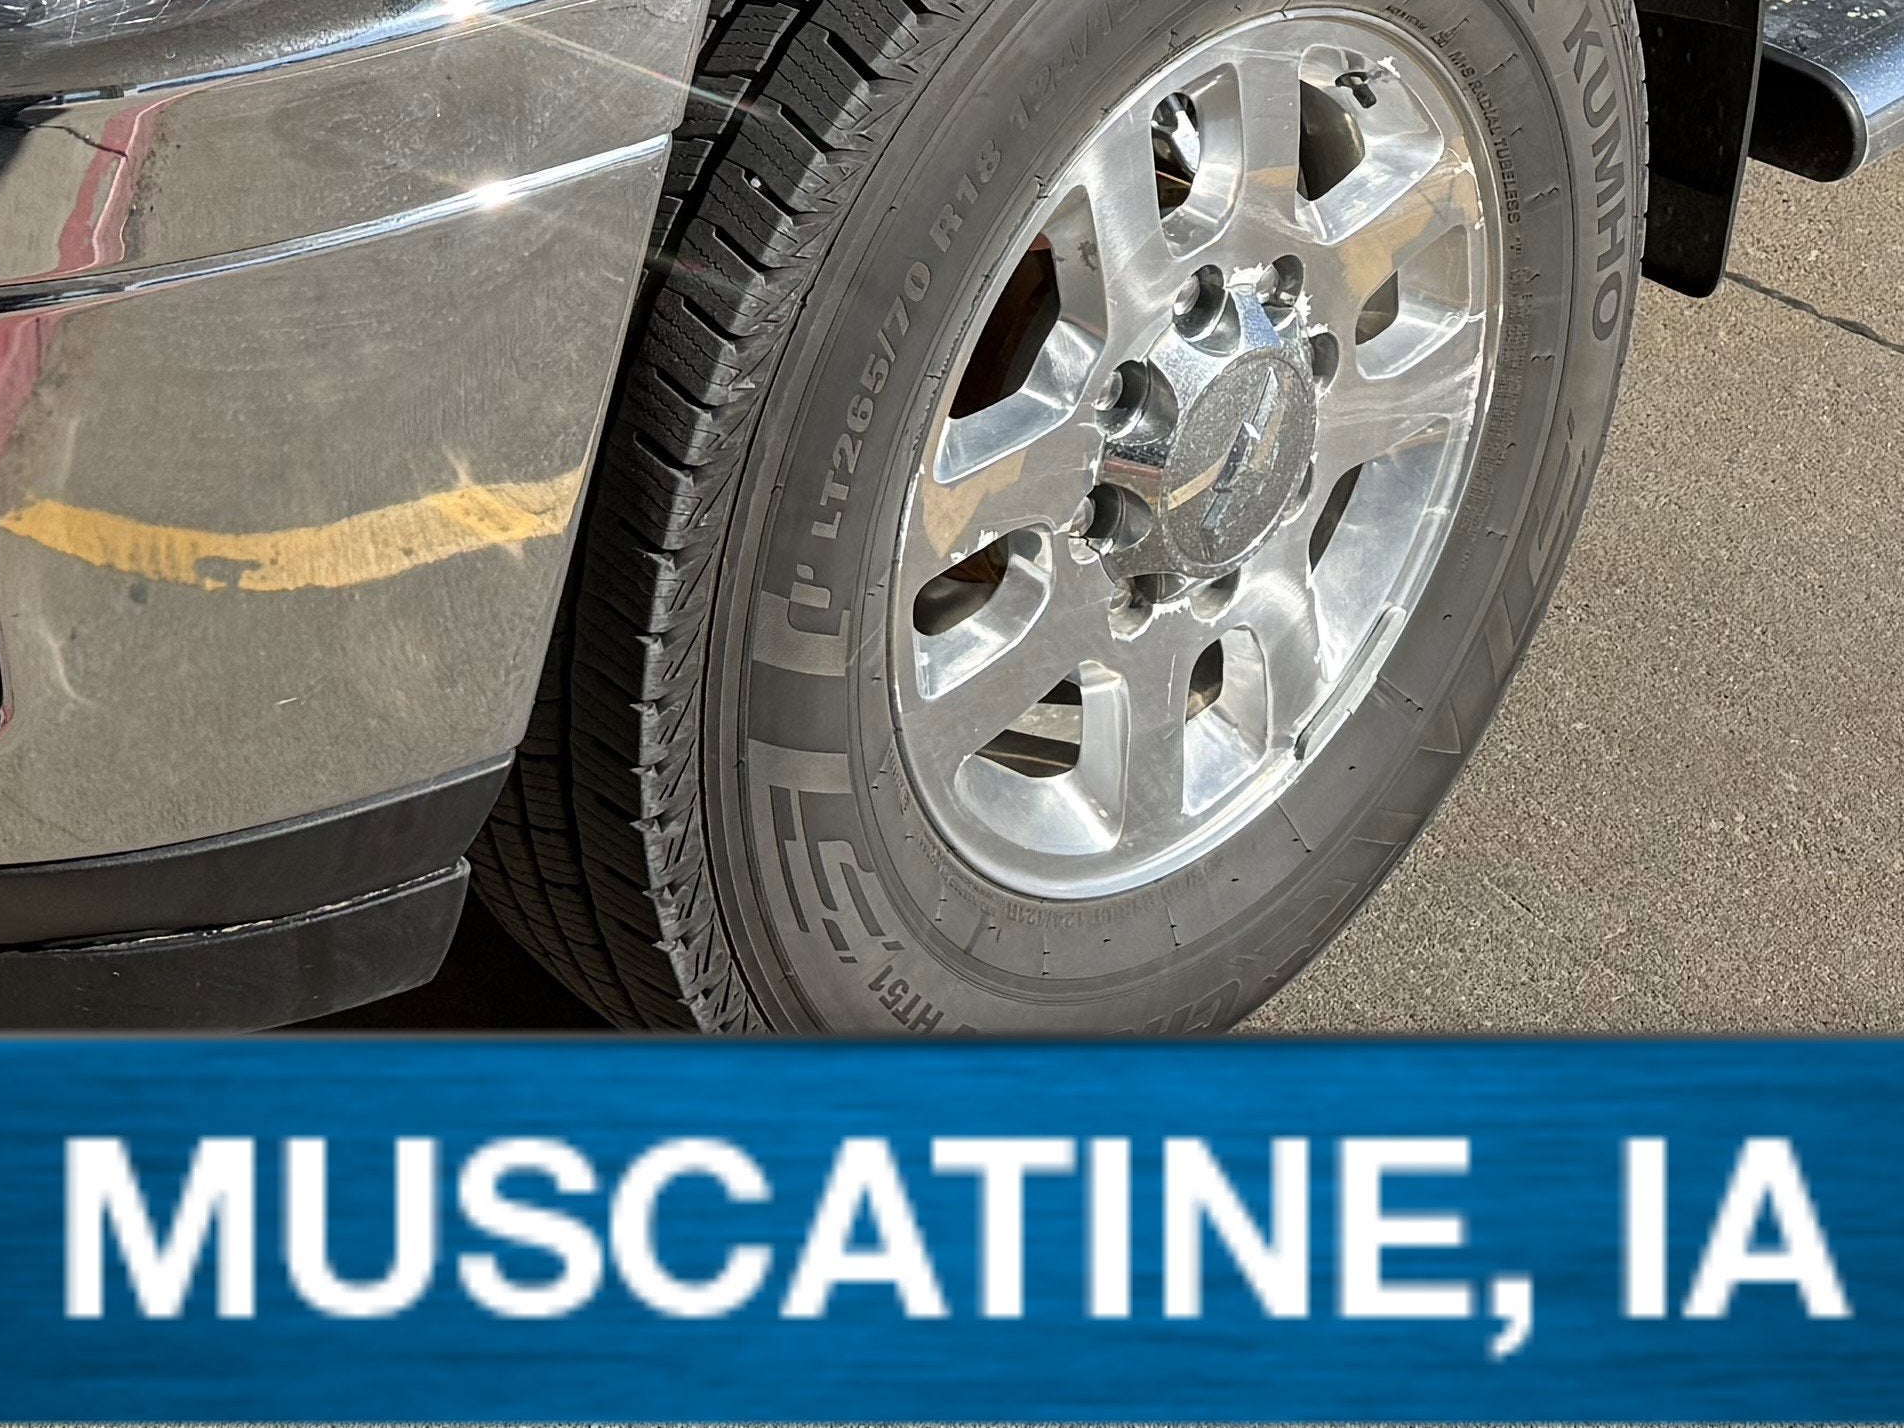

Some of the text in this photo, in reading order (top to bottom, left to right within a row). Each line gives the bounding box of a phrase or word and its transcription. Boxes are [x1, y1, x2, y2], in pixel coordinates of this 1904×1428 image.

[1467, 79, 1502, 136] RADIAL
[1494, 137, 1521, 225] TUBELESS
[1563, 6, 1626, 343] KUMHO
[811, 261, 932, 539] LT265/70
[929, 139, 1001, 253] R18
[868, 964, 945, 1036] HT51
